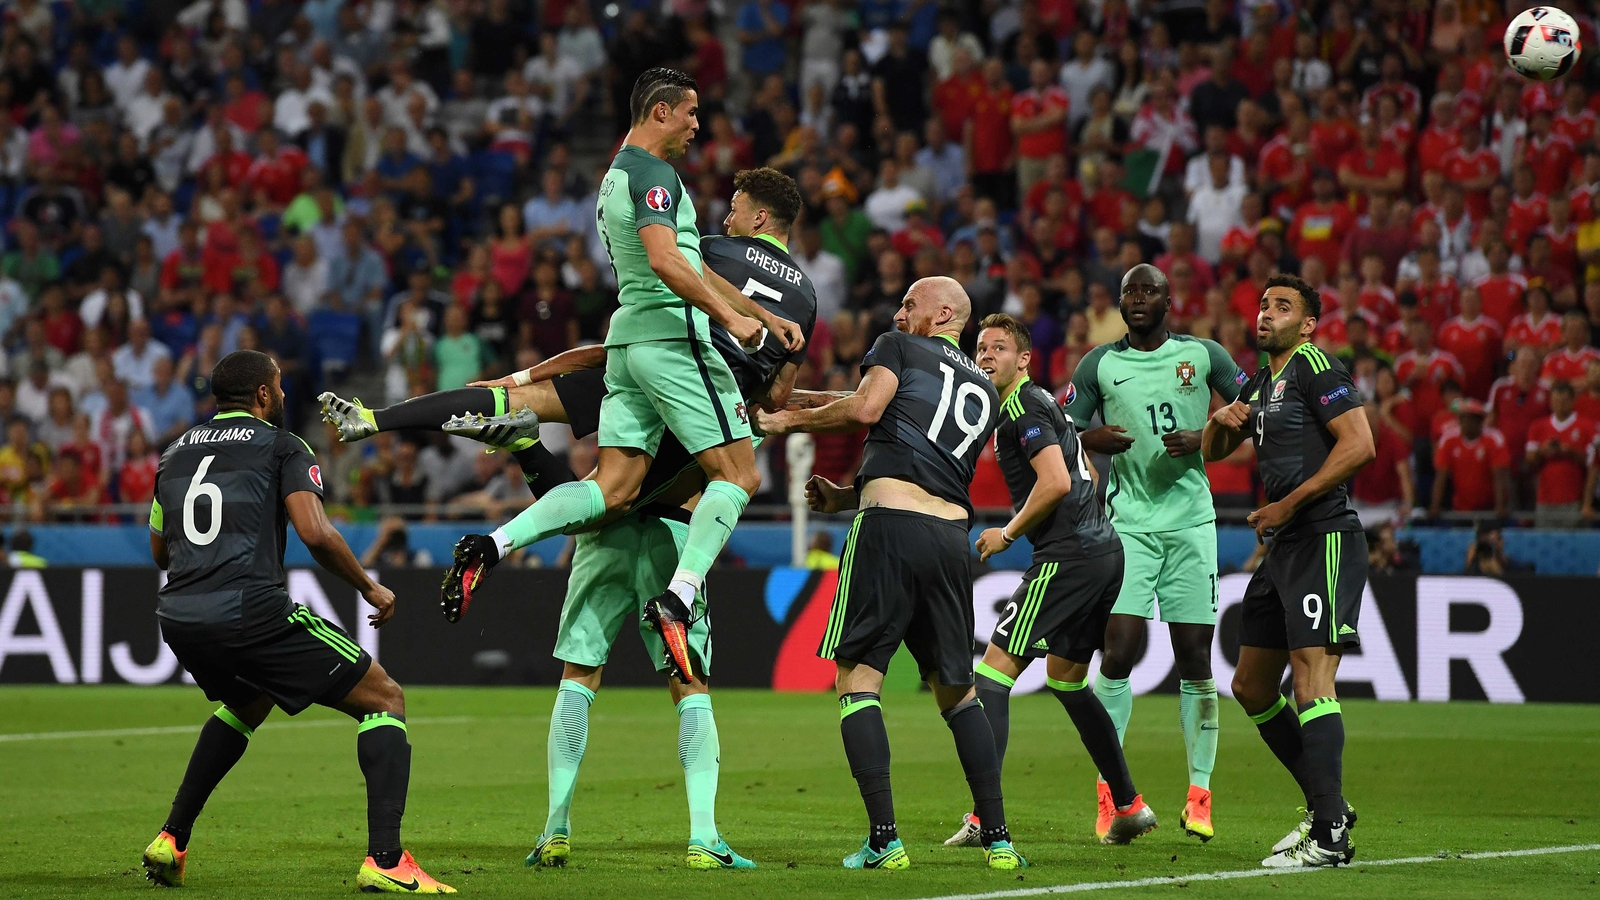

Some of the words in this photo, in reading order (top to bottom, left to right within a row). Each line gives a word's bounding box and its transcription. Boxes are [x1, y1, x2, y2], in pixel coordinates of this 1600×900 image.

[745, 246, 803, 287] CHESTER
[942, 345, 990, 381] COLLINS
[927, 361, 991, 460] 19
[1328, 387, 1349, 400] RESPECT
[1146, 402, 1177, 435] 13
[1256, 411, 1265, 446] 9
[176, 432, 186, 448] A.
[189, 428, 255, 444] WILLIAMS
[183, 455, 223, 546] 6
[0, 568, 379, 684] AIJN
[996, 601, 1018, 637] 2
[1302, 593, 1323, 630] 9
